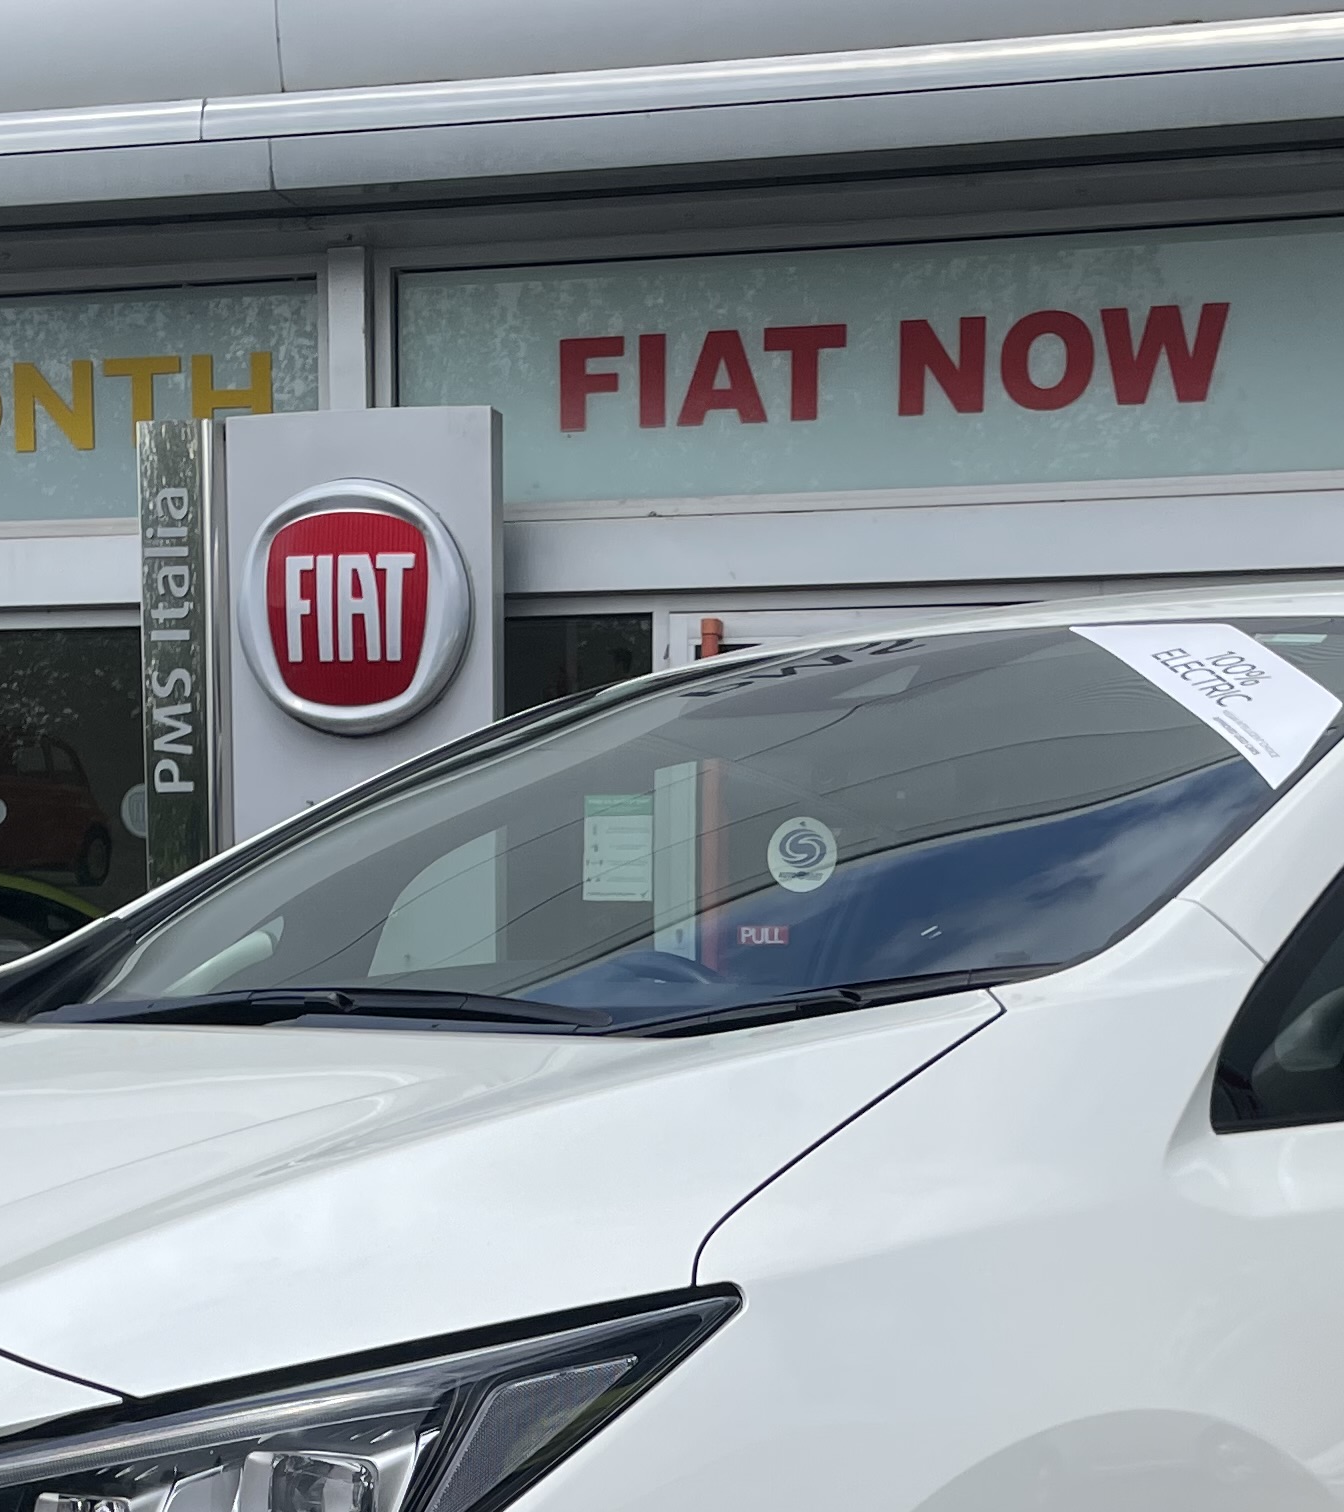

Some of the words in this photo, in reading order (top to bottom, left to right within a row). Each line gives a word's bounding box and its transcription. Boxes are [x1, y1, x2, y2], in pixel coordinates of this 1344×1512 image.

[559, 323, 847, 433] FIAT
[897, 302, 1230, 417] NOW
[144, 487, 192, 642] Italia
[284, 552, 417, 663] FIAT
[1151, 648, 1253, 708] ELECTRIC
[1205, 650, 1272, 686] 100%
[153, 667, 195, 793] PMS
[740, 927, 785, 945] PULL
